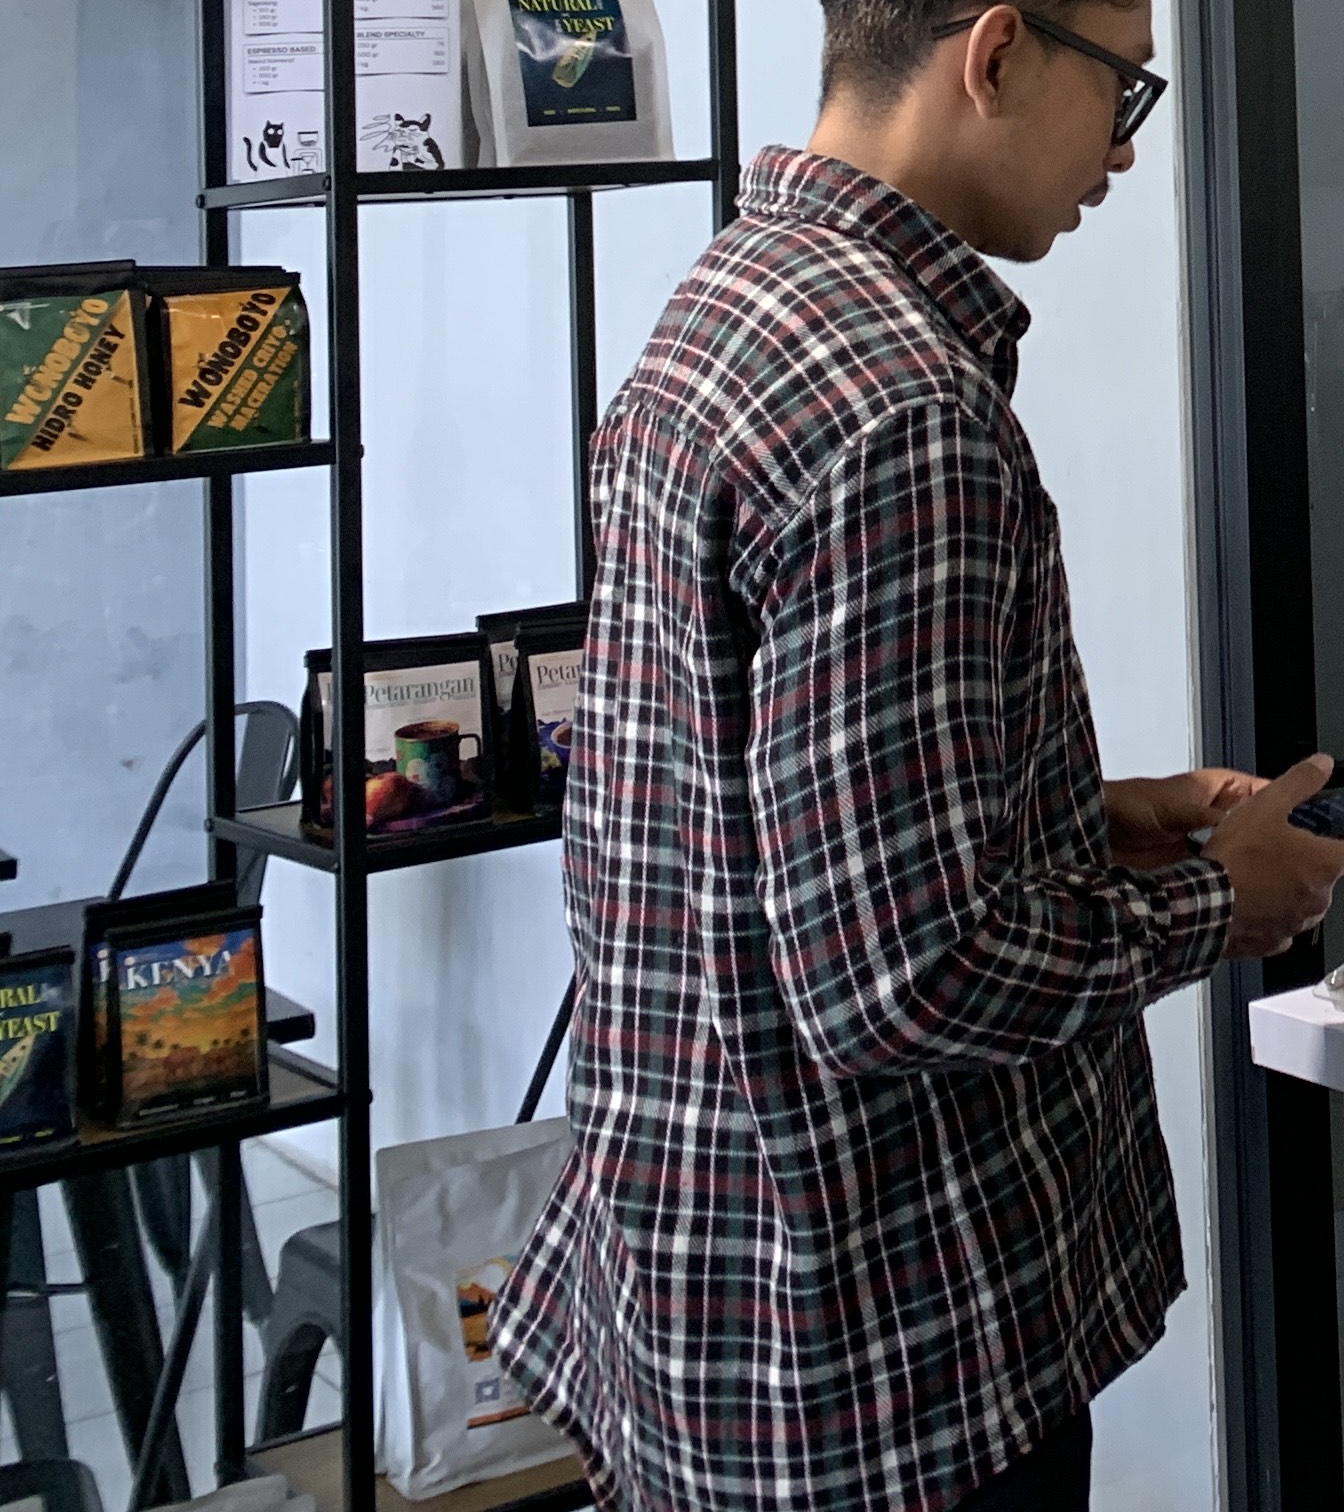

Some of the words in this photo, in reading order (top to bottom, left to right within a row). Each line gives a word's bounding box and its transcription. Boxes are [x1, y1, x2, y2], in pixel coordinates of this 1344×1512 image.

[562, 16, 615, 33] YEAST
[73, 323, 126, 390] HONEY
[178, 292, 276, 409] WONOBOYO
[126, 949, 231, 990] KENYA
